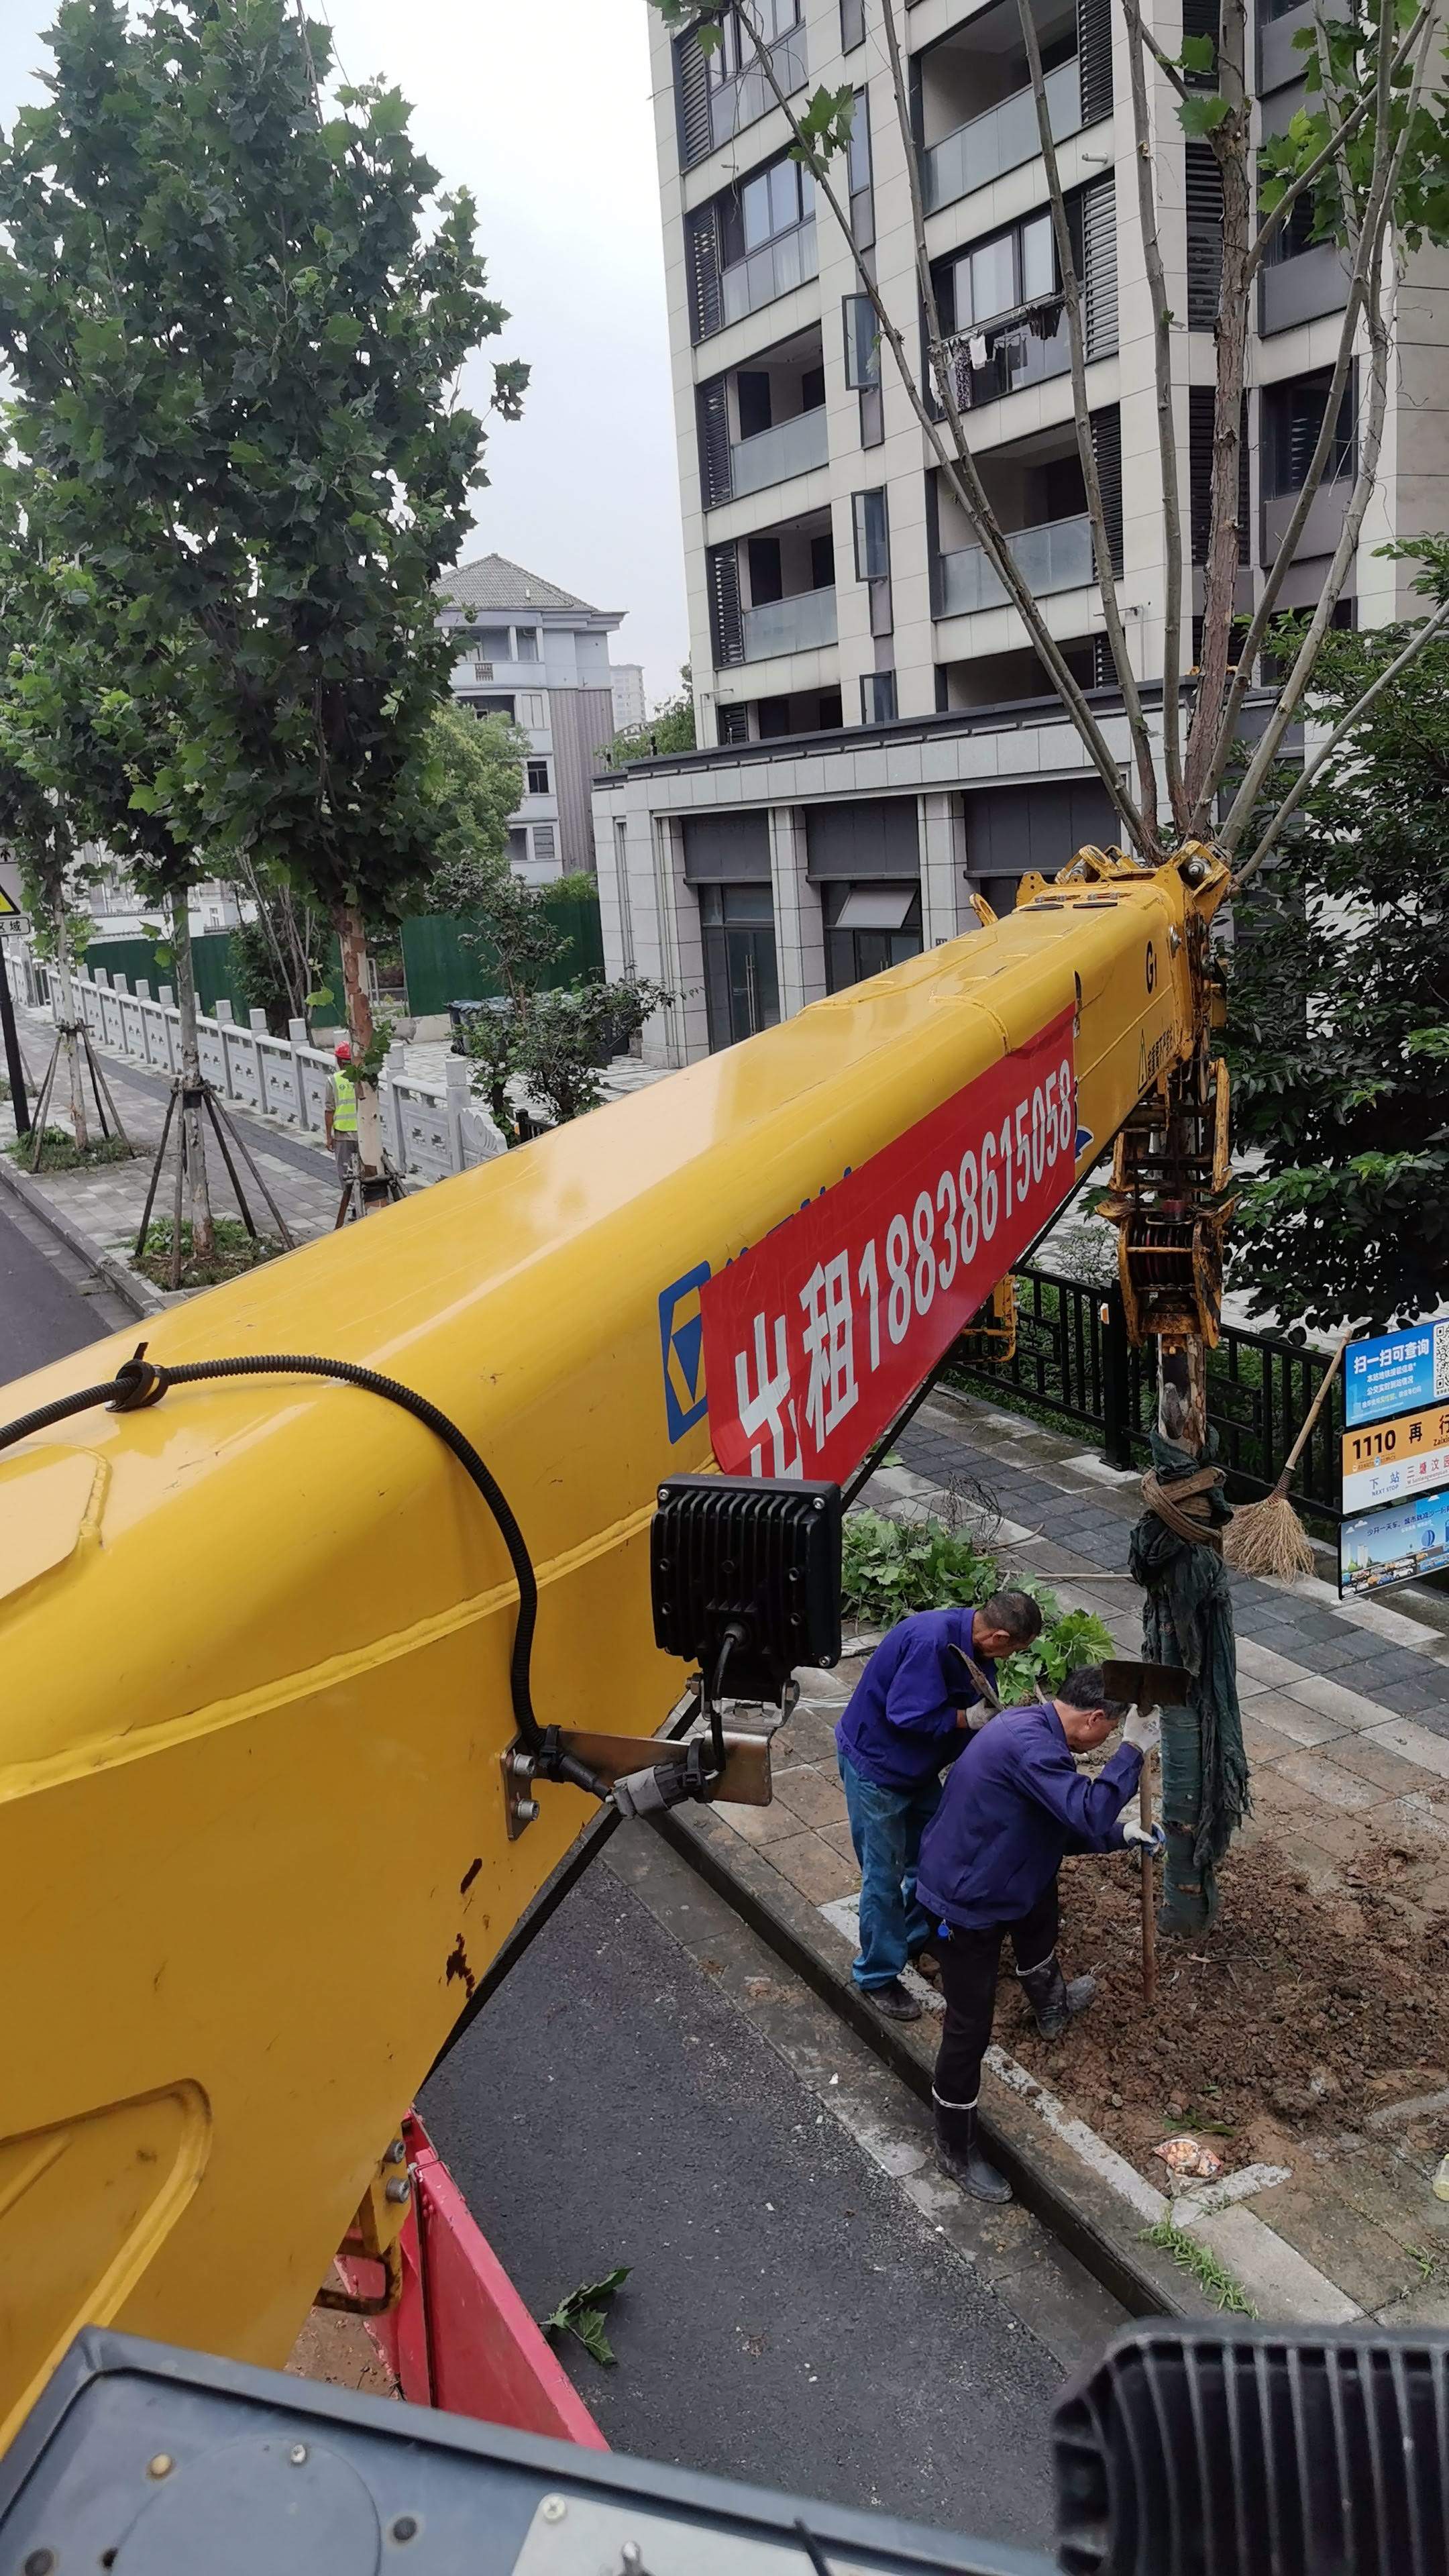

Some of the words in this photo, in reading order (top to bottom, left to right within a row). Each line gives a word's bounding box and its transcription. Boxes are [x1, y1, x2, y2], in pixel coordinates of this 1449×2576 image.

[1353, 1338, 1430, 1374] 扫一扫可查询
[1352, 1430, 1396, 1459] 1110
[1372, 1487, 1385, 1496] NEXT
[1386, 1484, 1399, 1493] STOP
